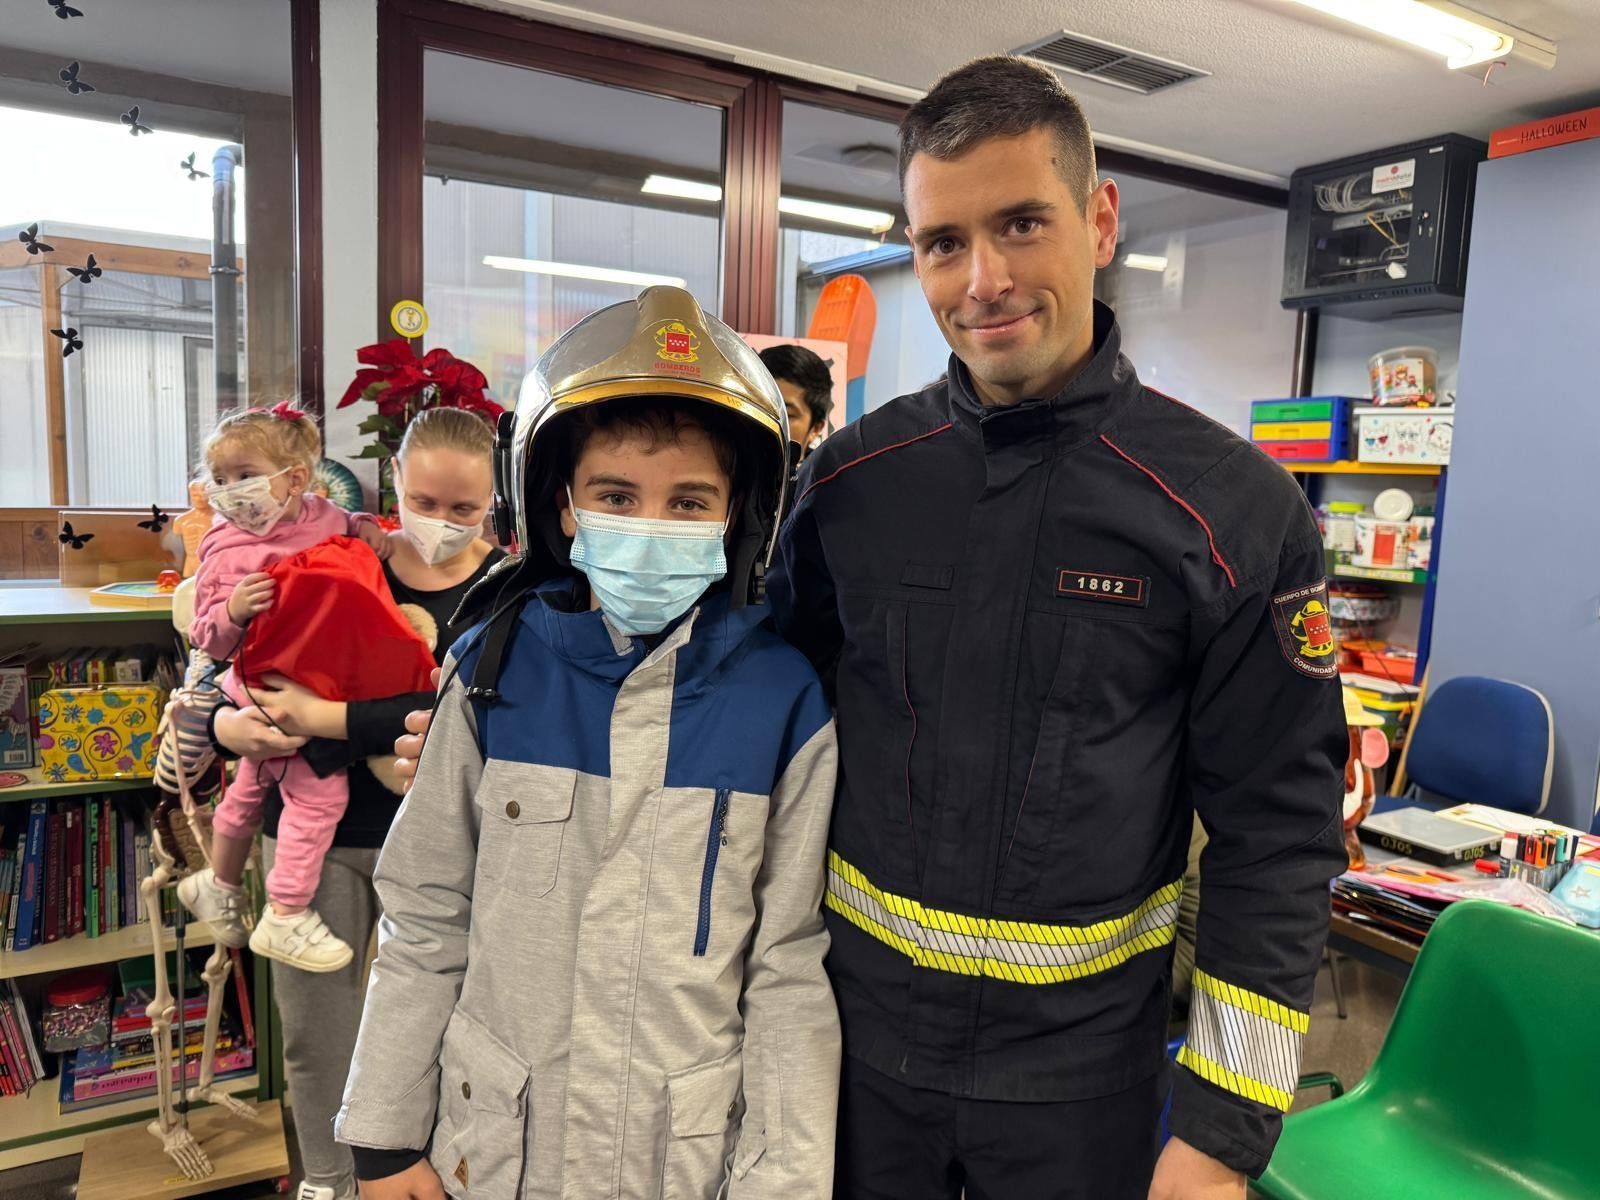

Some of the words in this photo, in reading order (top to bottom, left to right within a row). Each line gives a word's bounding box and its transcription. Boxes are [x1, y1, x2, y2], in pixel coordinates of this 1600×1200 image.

[1521, 116, 1587, 144] HALLOWEEN
[1077, 577, 1124, 594] 1862
[1274, 592, 1300, 604] CUERPO
[1300, 588, 1310, 597] DE
[1463, 845, 1486, 862] OJOS
